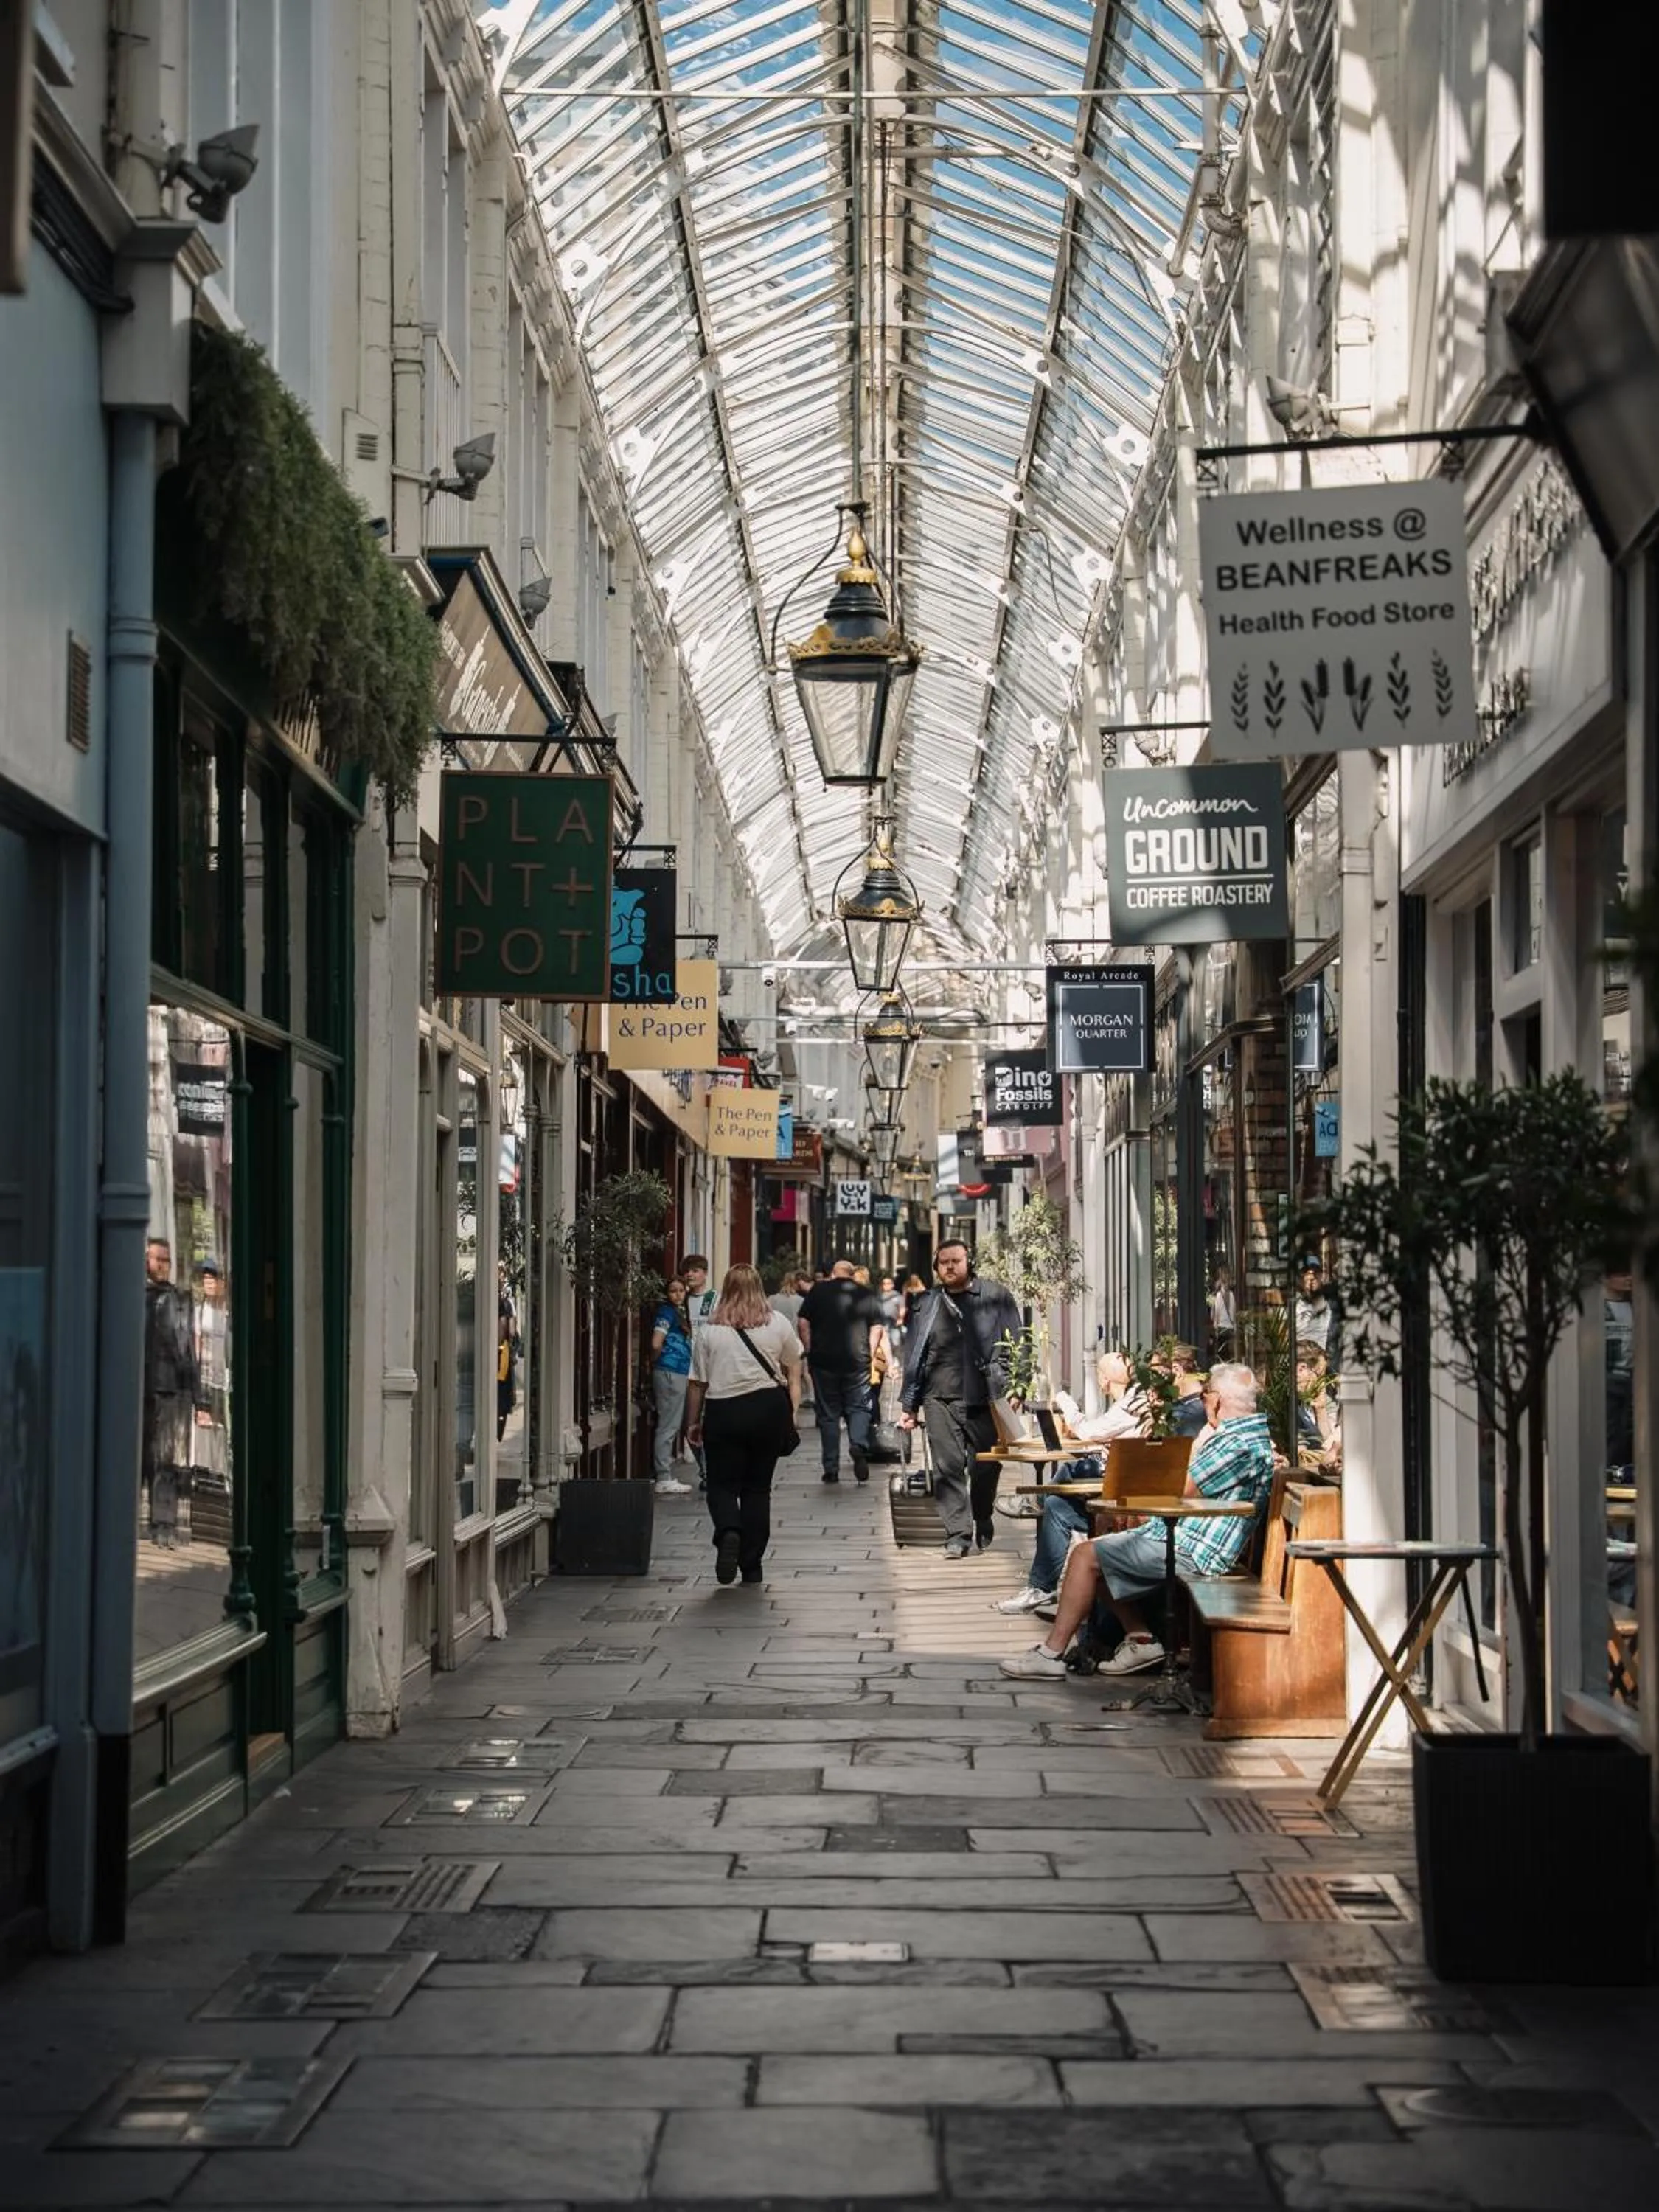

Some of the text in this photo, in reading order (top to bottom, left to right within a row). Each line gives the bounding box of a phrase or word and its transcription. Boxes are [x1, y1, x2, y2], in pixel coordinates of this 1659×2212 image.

[1236, 507, 1427, 546] Wellness @
[1217, 549, 1453, 591] BEANFREAKS
[1219, 602, 1455, 635] Health Food Store
[1123, 796, 1259, 824] Uncommon
[1124, 826, 1269, 875] GROUND
[1126, 883, 1274, 909] COFFEE ROASTERY
[1064, 970, 1139, 982] Royal Arcade
[618, 1018, 707, 1043] & Paper
[1069, 1013, 1134, 1029] MORGAN
[1075, 1029, 1127, 1040] QUARTER
[995, 1066, 1053, 1088] Dino
[995, 1088, 1053, 1101] Fossils
[717, 1106, 773, 1122] The Pen
[714, 1124, 725, 1137] &
[729, 1124, 770, 1141] Paper
